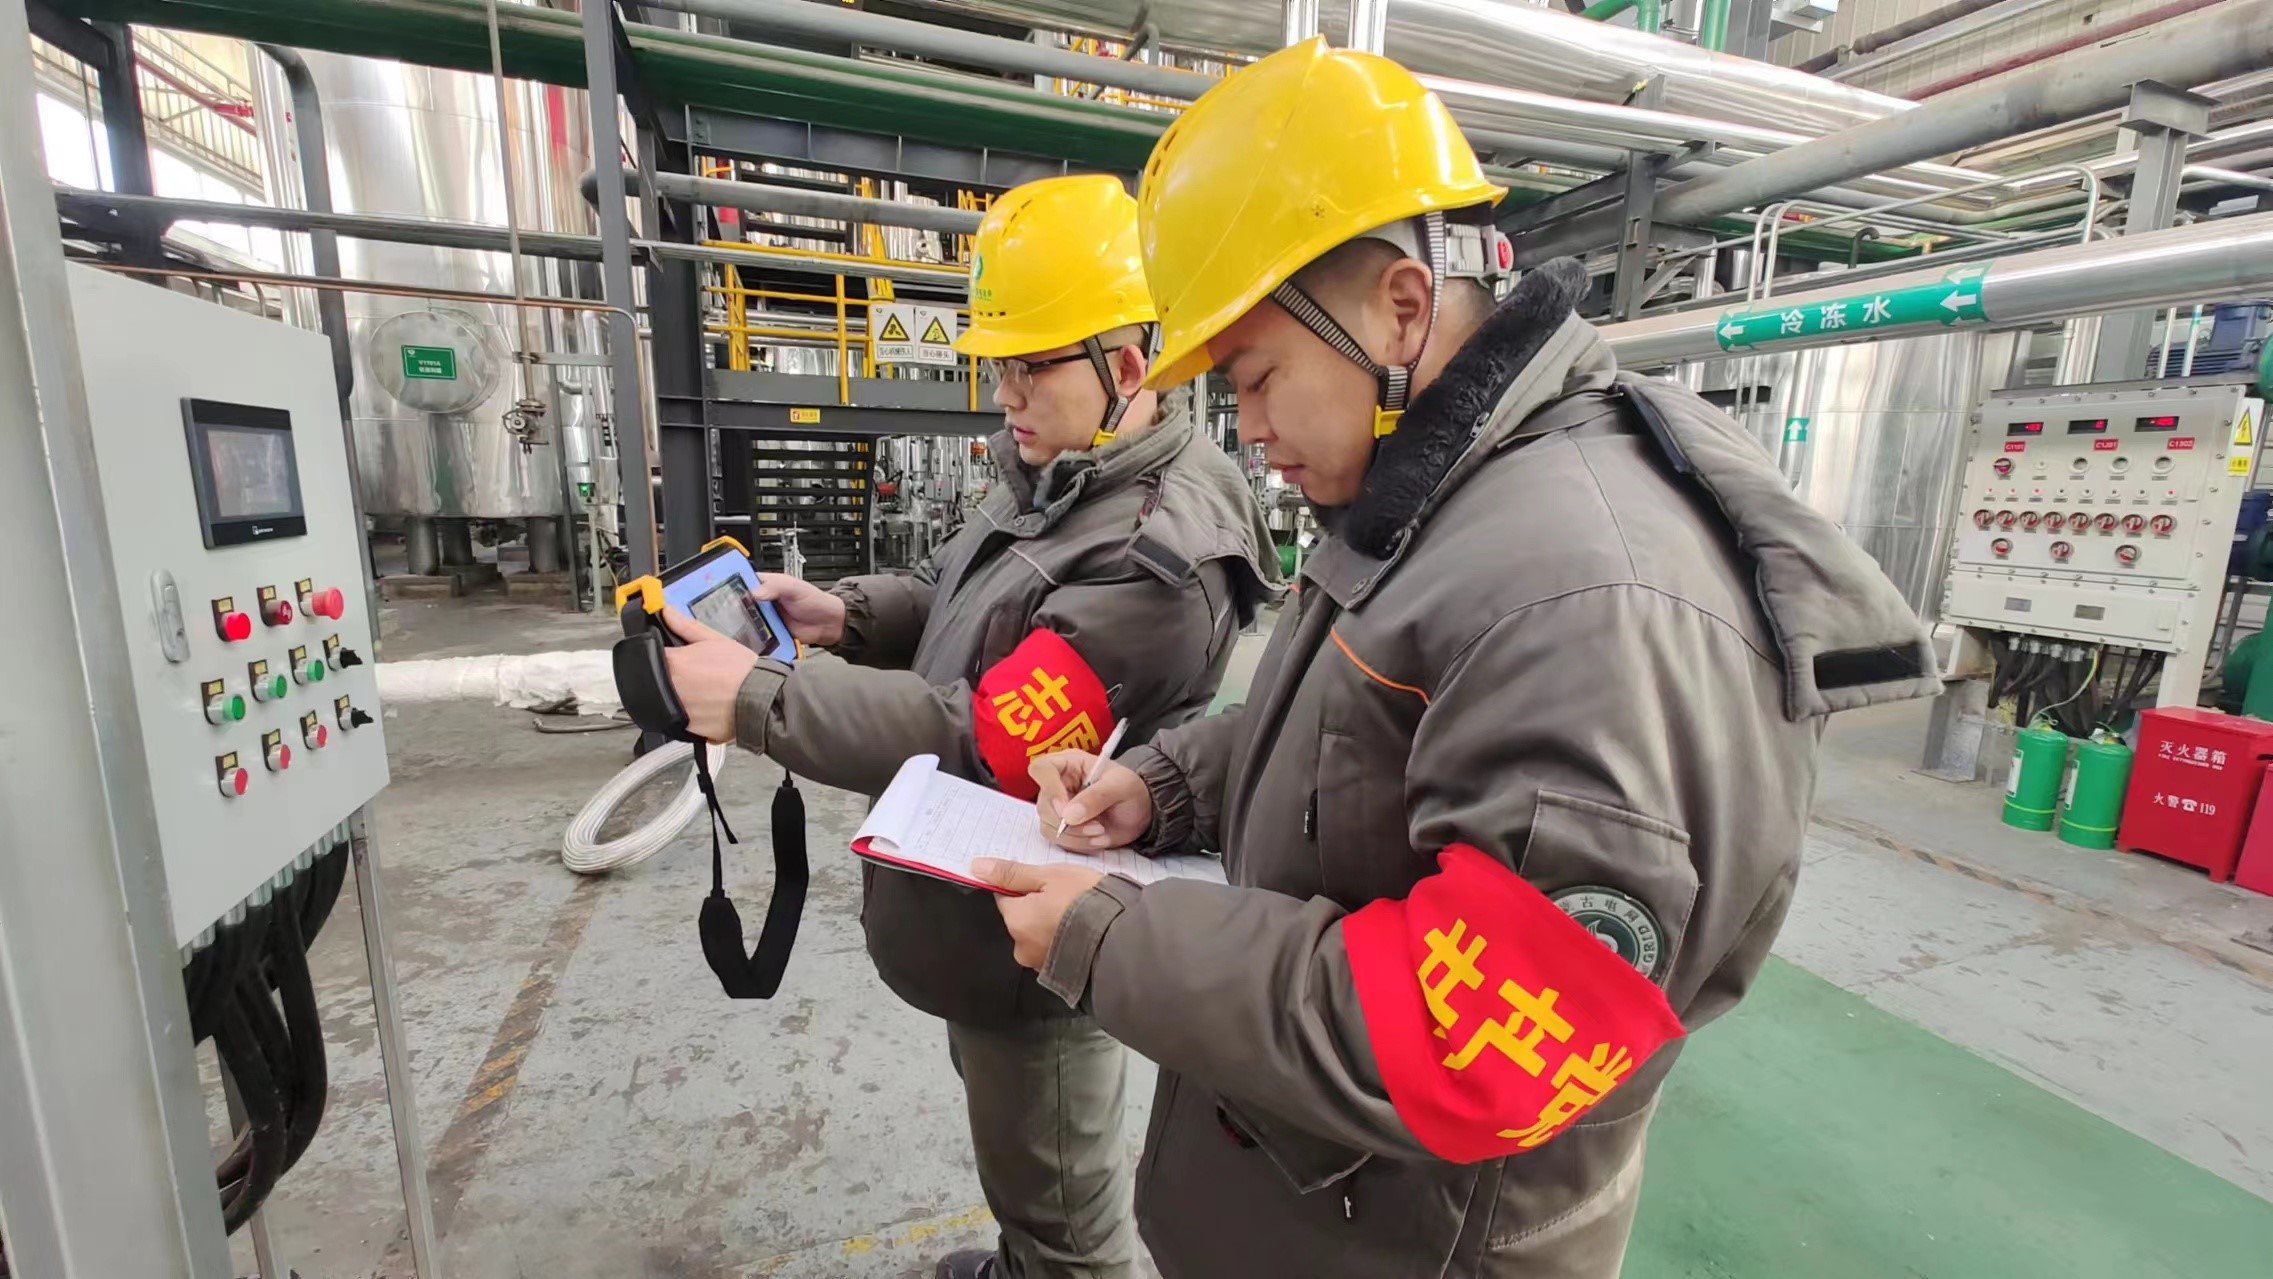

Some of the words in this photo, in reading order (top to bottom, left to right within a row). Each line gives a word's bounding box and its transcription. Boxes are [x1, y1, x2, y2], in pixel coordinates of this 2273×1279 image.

[1779, 296, 1892, 335] 冷冻水
[2159, 740, 2227, 765] 灭火器箱
[2153, 792, 2179, 808] 火警
[2200, 803, 2216, 816] 119
